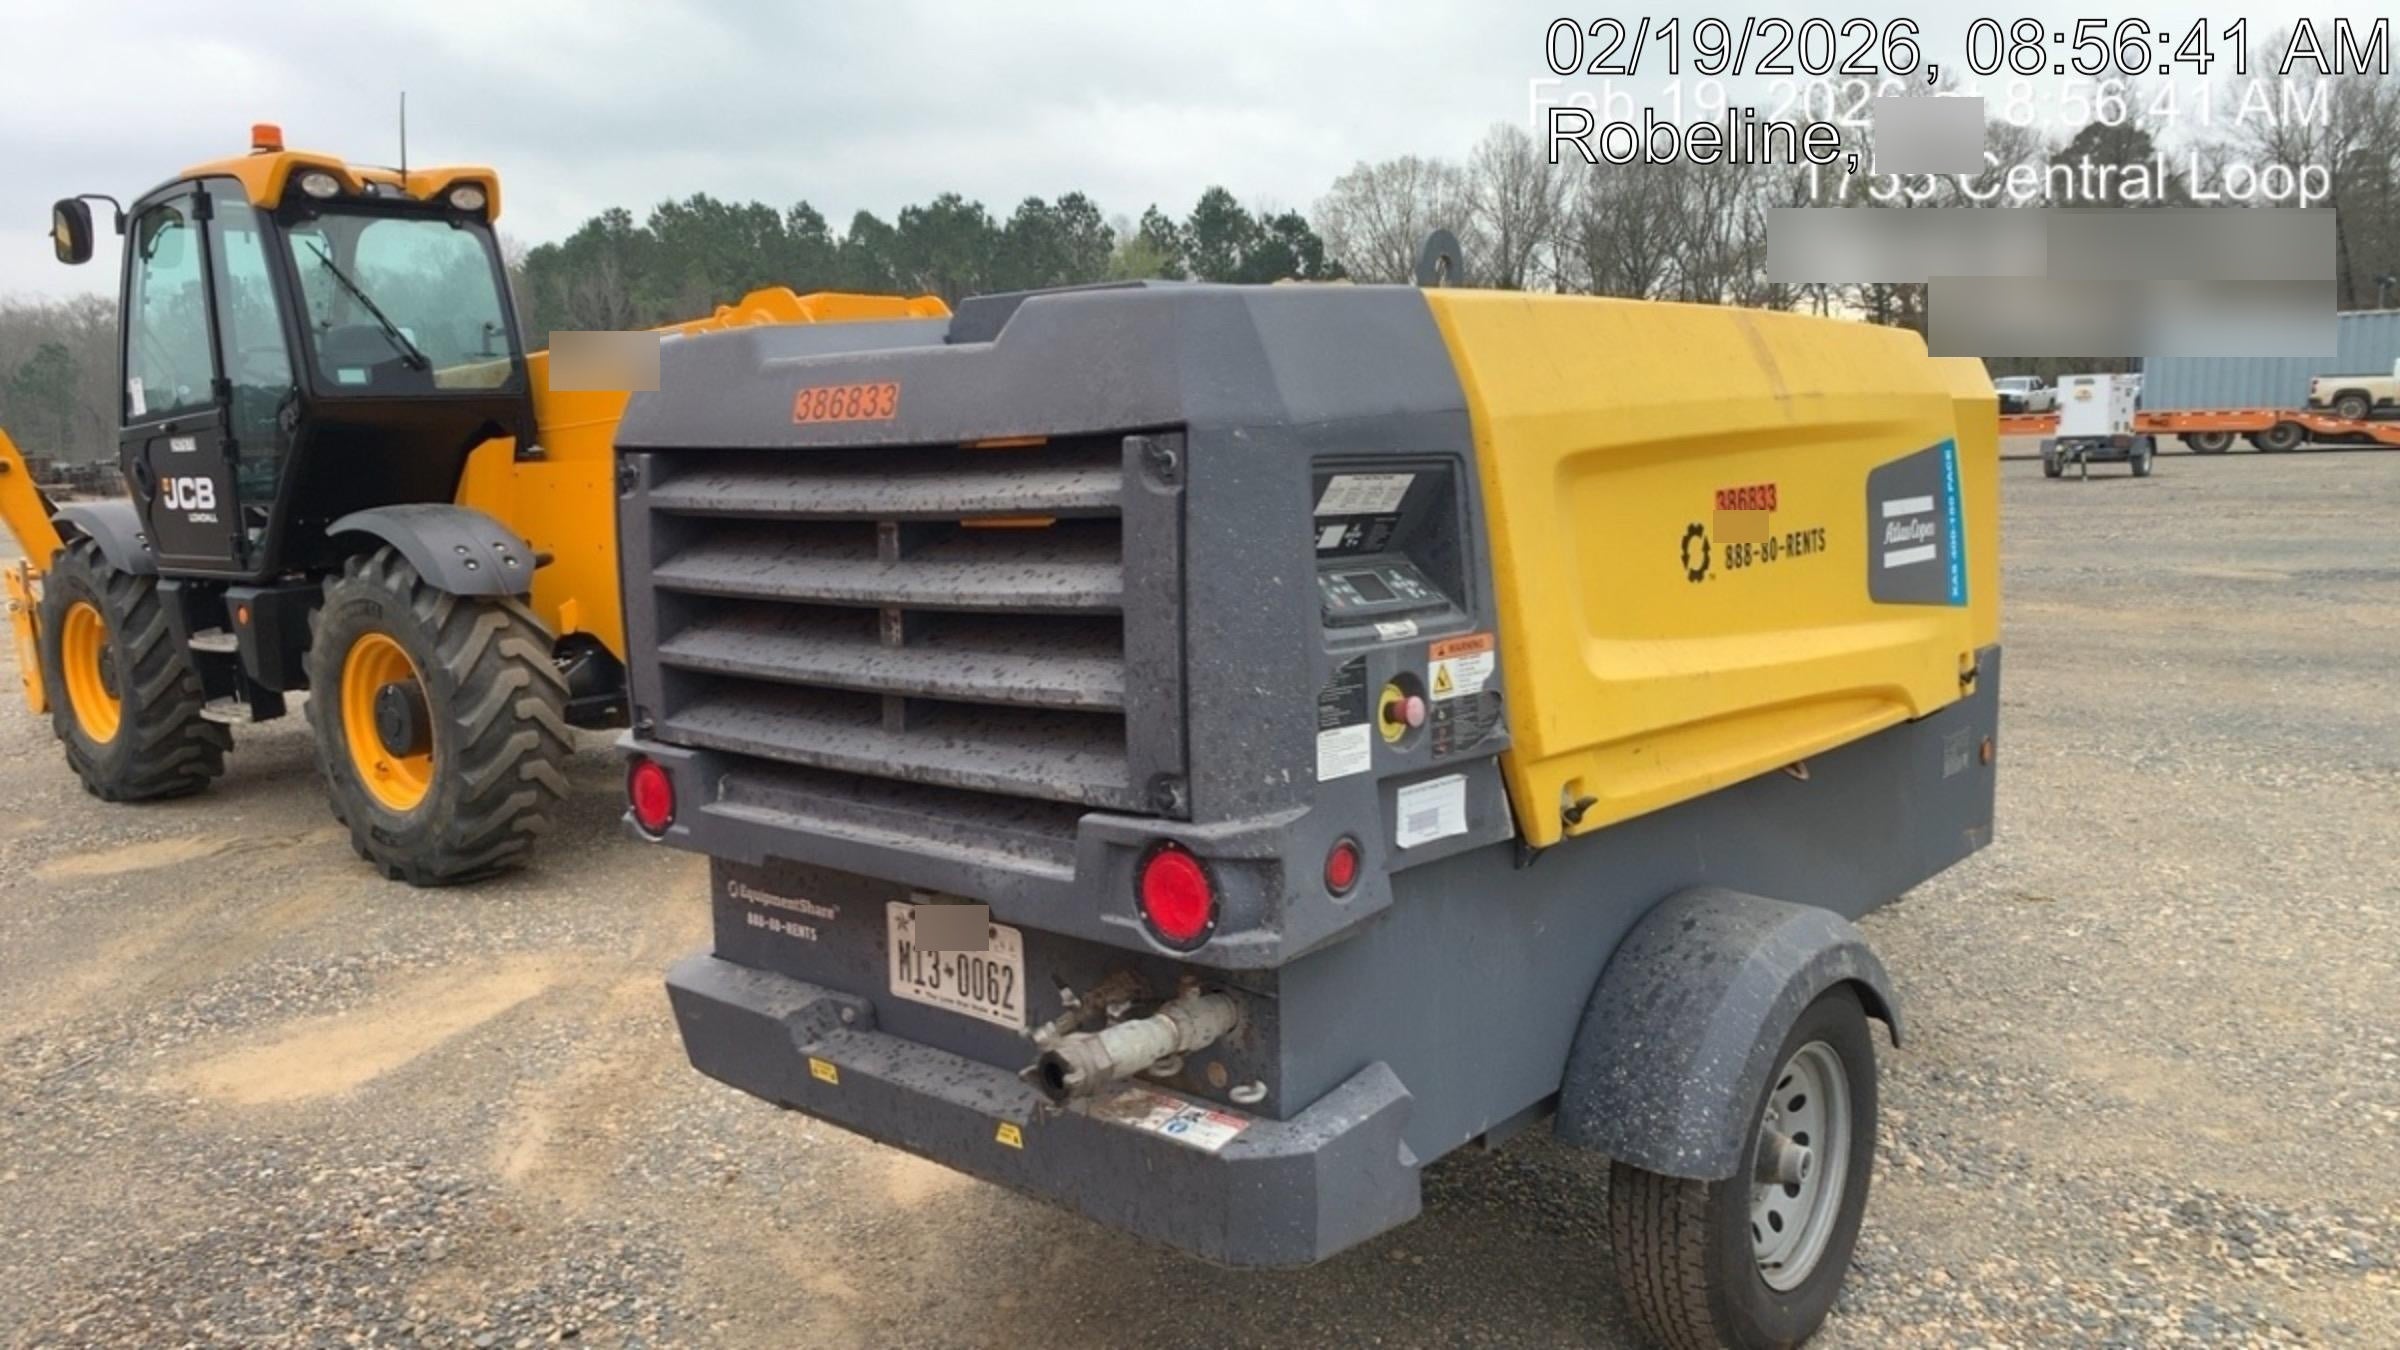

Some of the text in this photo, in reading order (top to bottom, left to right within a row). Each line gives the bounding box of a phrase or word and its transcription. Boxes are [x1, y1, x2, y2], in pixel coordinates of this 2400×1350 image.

[796, 383, 897, 421] 386833
[162, 476, 216, 510] JCB
[1716, 483, 1777, 512] 386833
[1725, 527, 1826, 571] 888-80-RENTS
